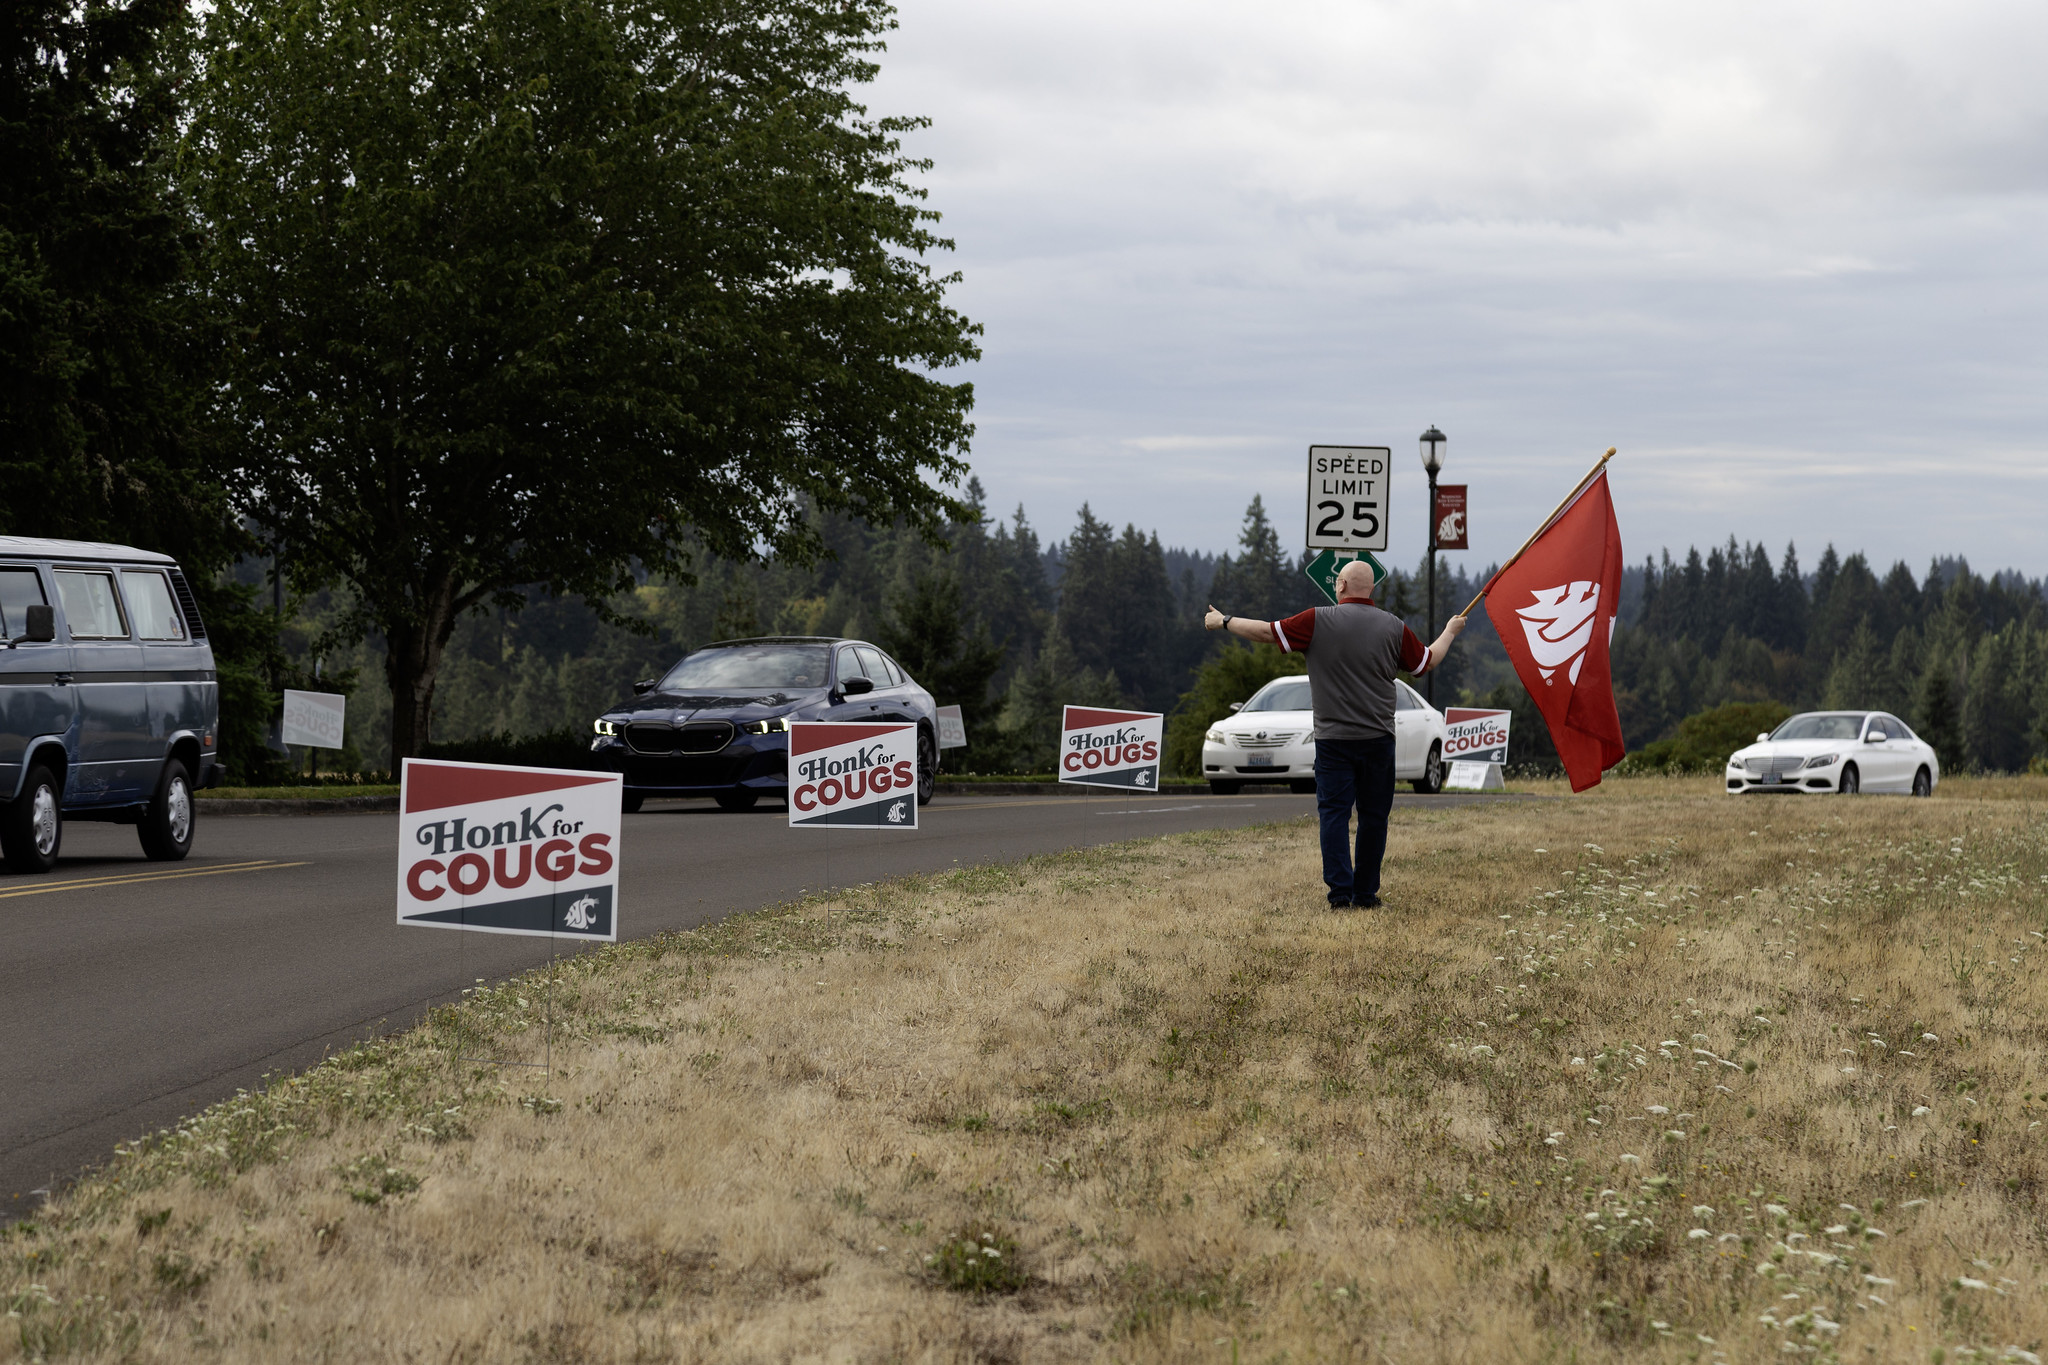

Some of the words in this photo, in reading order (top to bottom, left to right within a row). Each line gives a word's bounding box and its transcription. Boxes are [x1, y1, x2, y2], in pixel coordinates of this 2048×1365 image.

[1316, 458, 1383, 475] SPEED
[1322, 479, 1375, 495] LIMIT
[1315, 500, 1380, 538] 25
[1069, 727, 1137, 751] Honk
[1130, 734, 1146, 743] for
[1444, 729, 1507, 754] COUGS
[1448, 720, 1493, 738] Honk
[798, 744, 884, 782] Honk
[877, 753, 896, 765] for
[1063, 740, 1158, 772] COUGS
[793, 760, 914, 812] COUGS
[416, 803, 564, 855] Honk
[552, 819, 584, 837] for
[406, 832, 613, 902] COUGS
